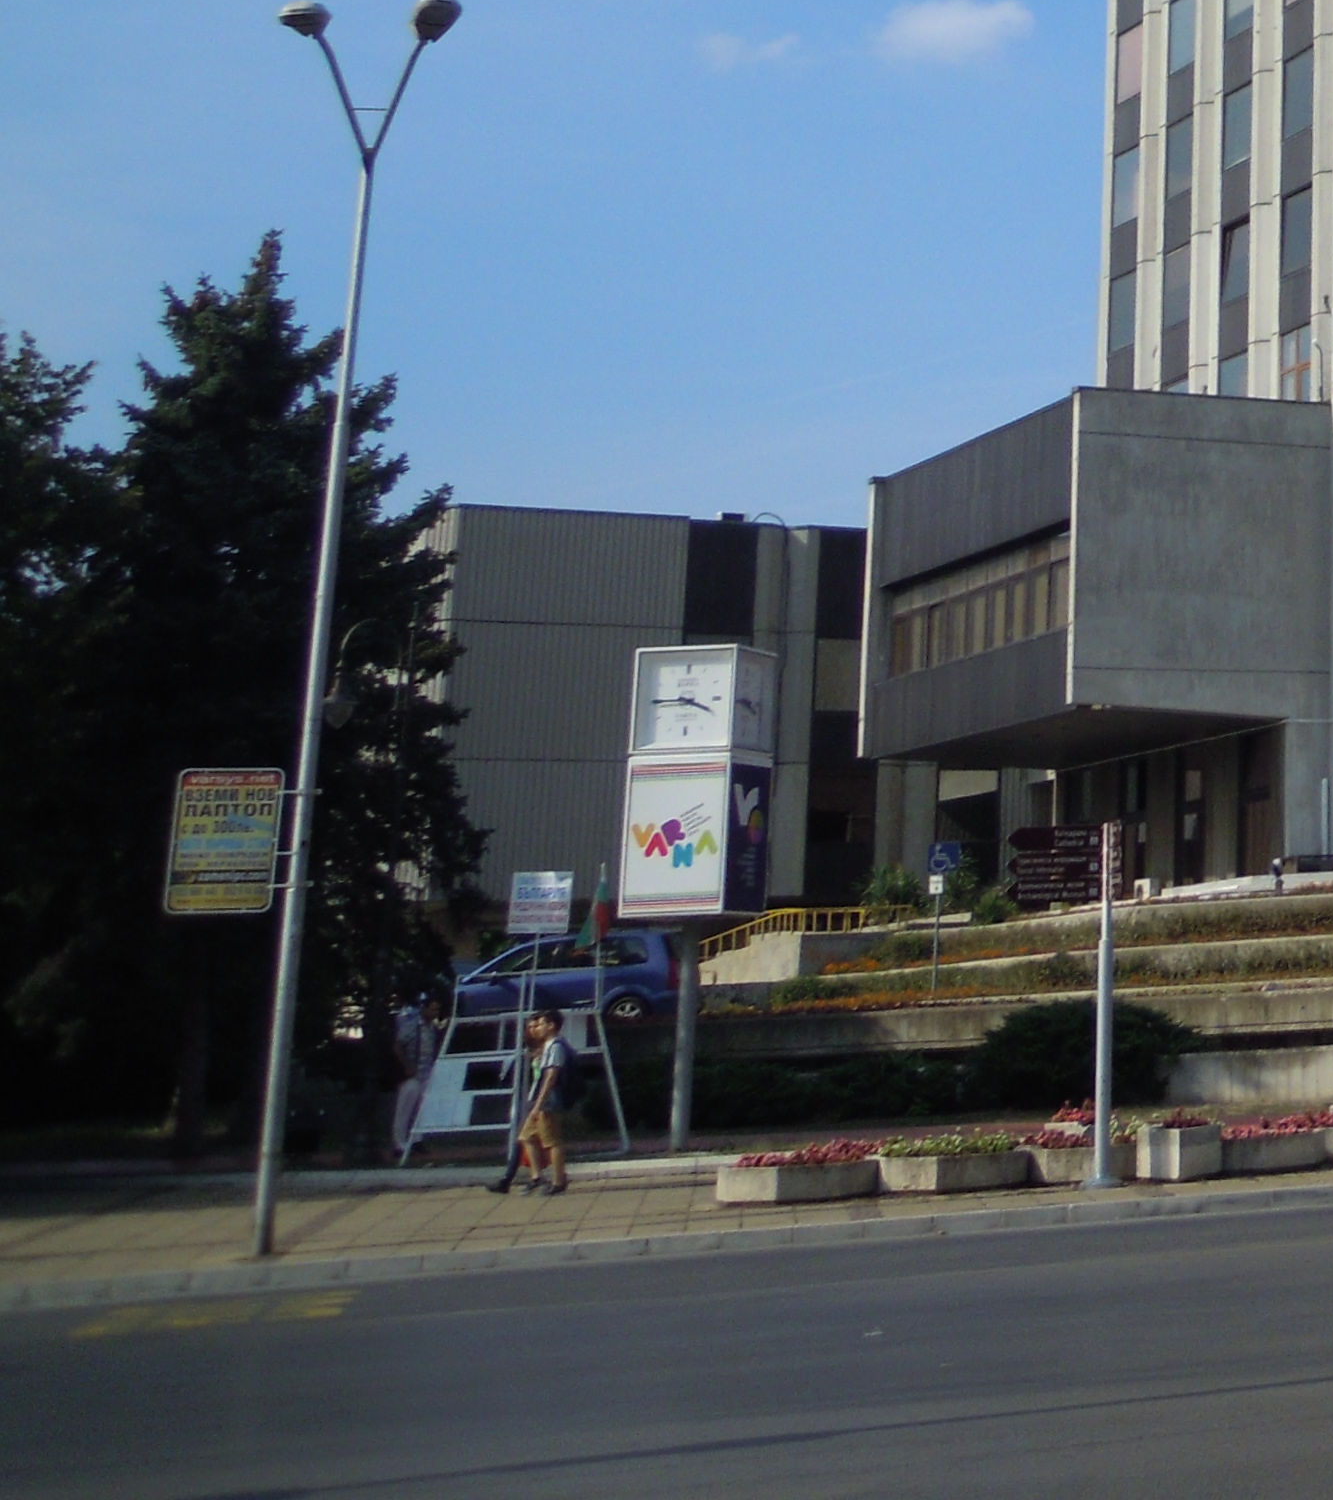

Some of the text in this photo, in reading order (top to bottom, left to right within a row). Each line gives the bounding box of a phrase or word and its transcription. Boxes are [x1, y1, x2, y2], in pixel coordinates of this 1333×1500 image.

[184, 787, 276, 802] ВЗЕМИ НОВ
[184, 803, 273, 817] ЛАПТОП
[632, 818, 718, 868] VARNA
